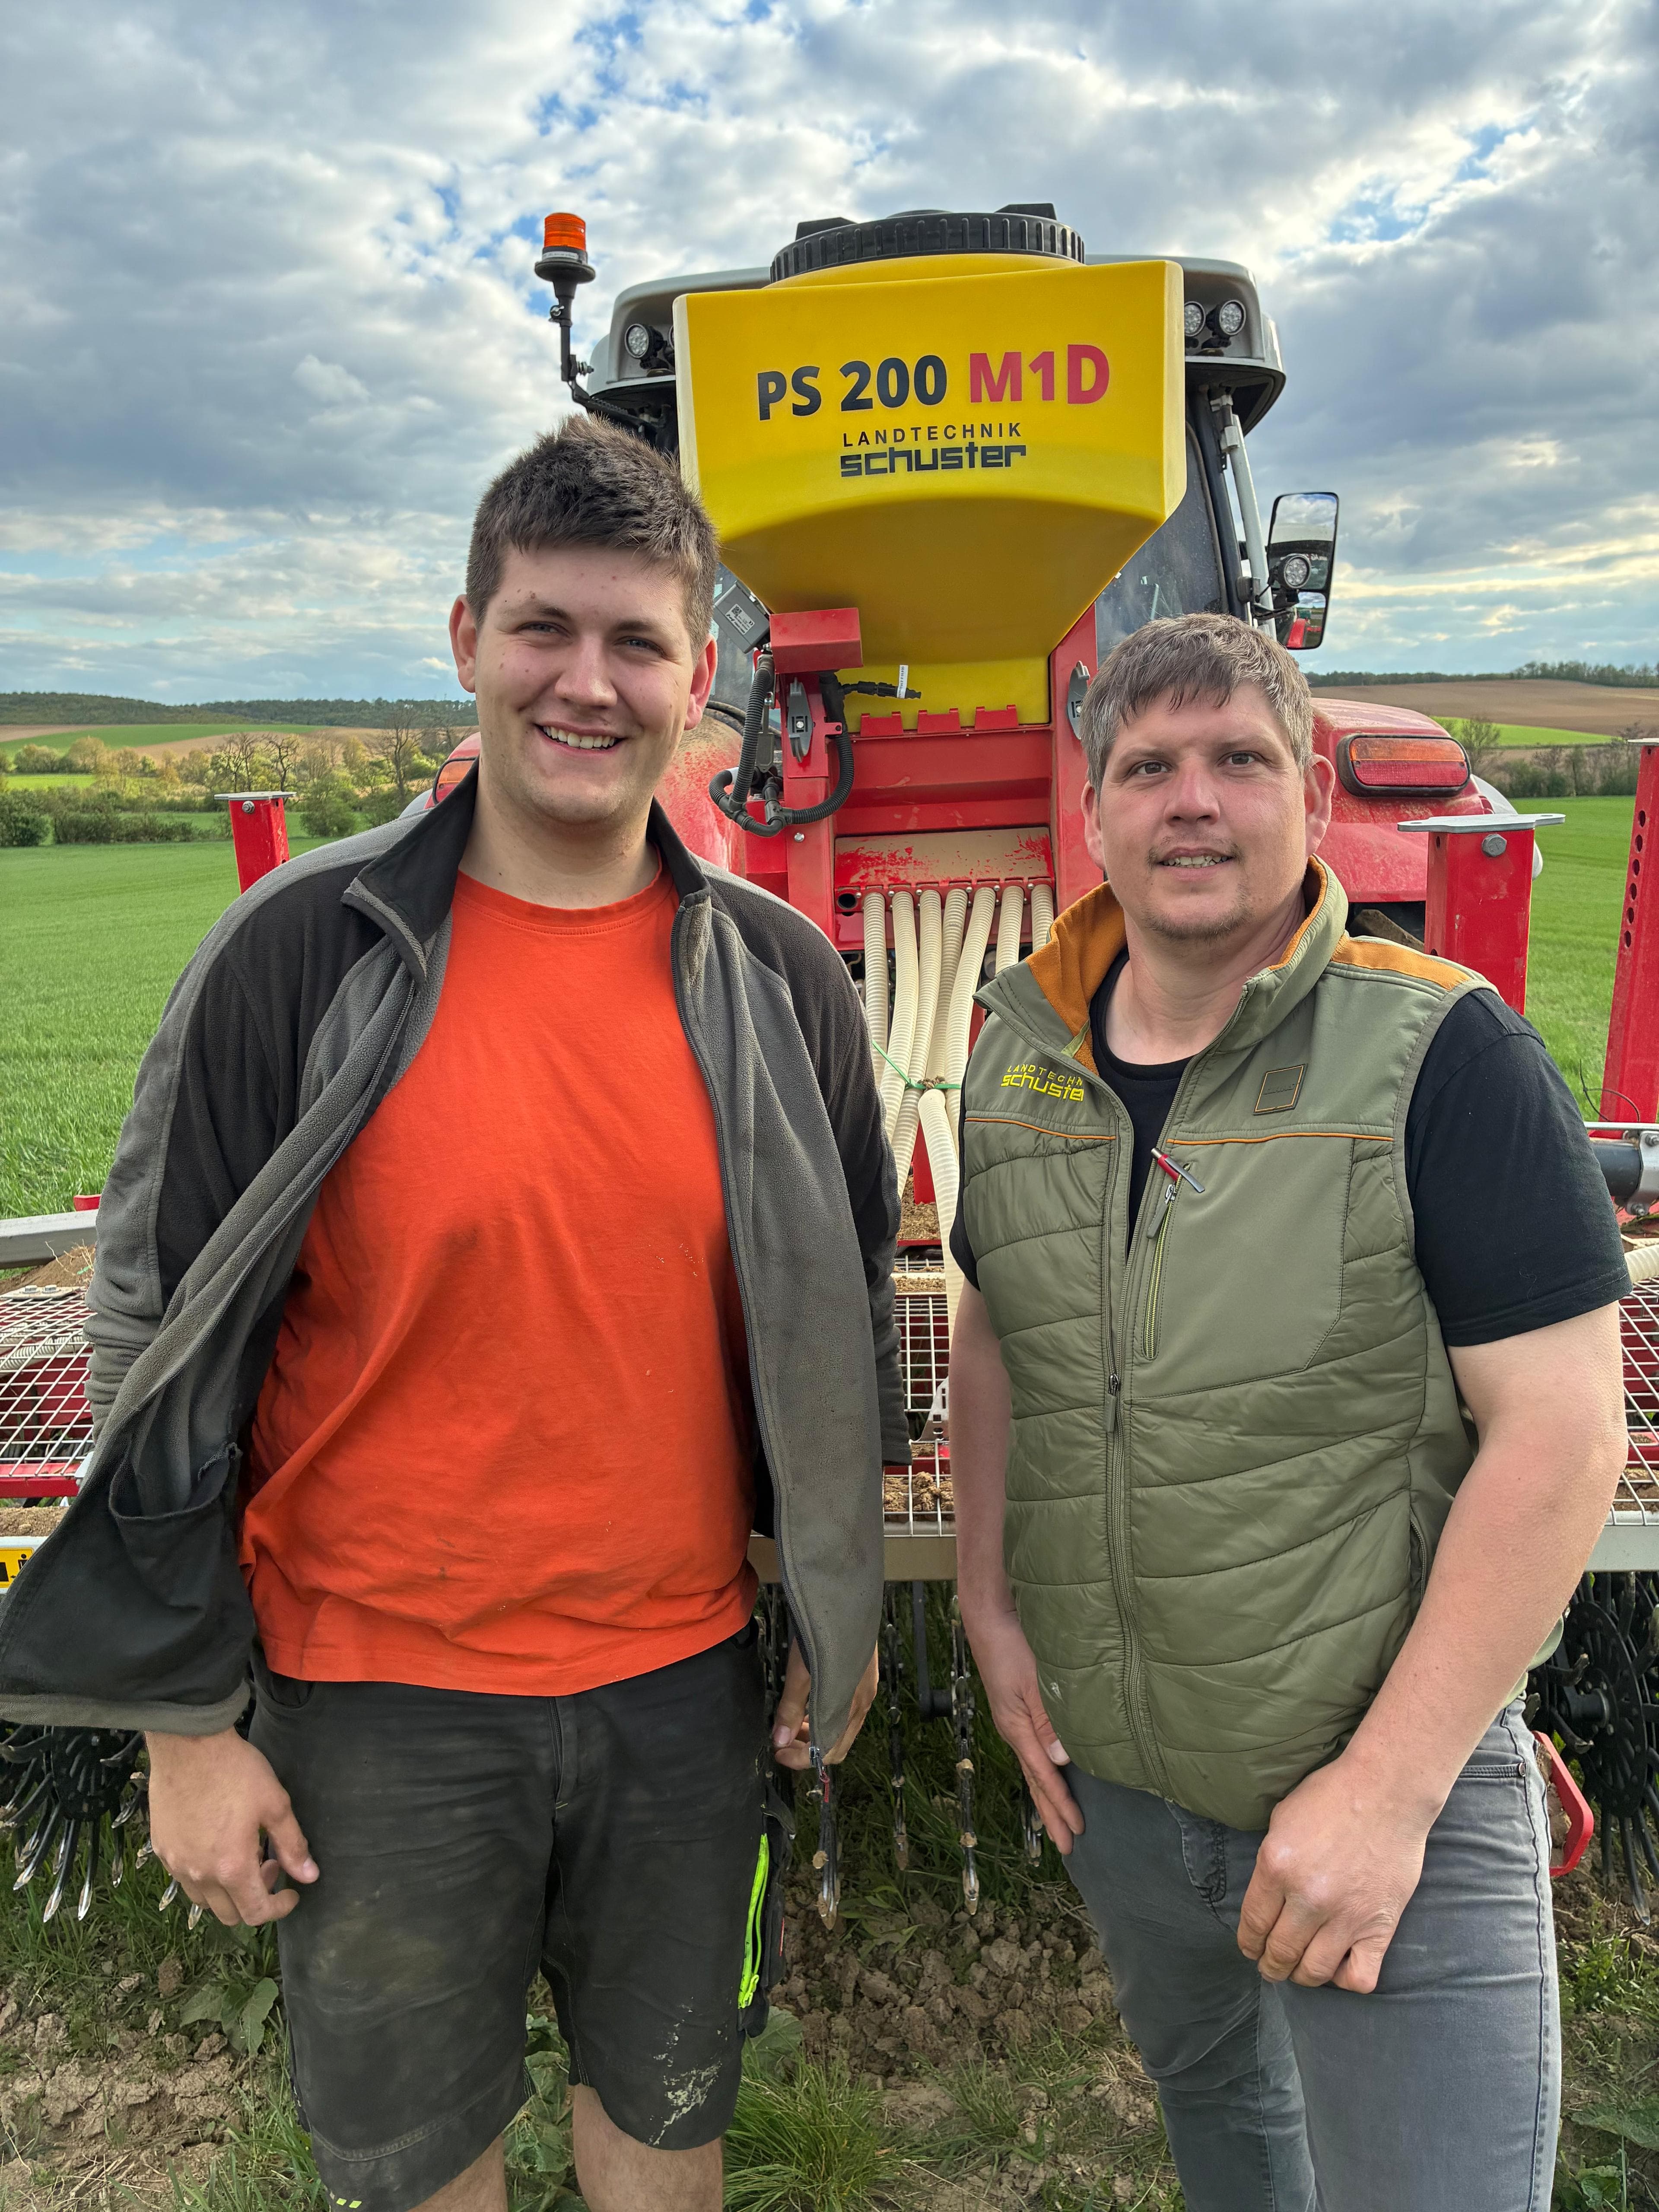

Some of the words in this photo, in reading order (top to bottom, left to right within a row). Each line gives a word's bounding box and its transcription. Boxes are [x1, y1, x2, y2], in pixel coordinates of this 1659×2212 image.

[758, 366, 822, 420] PS
[839, 355, 947, 411] 200
[969, 344, 1109, 405] M1D
[843, 423, 1021, 447] LANDTECHNIK
[840, 442, 1026, 477] schuster
